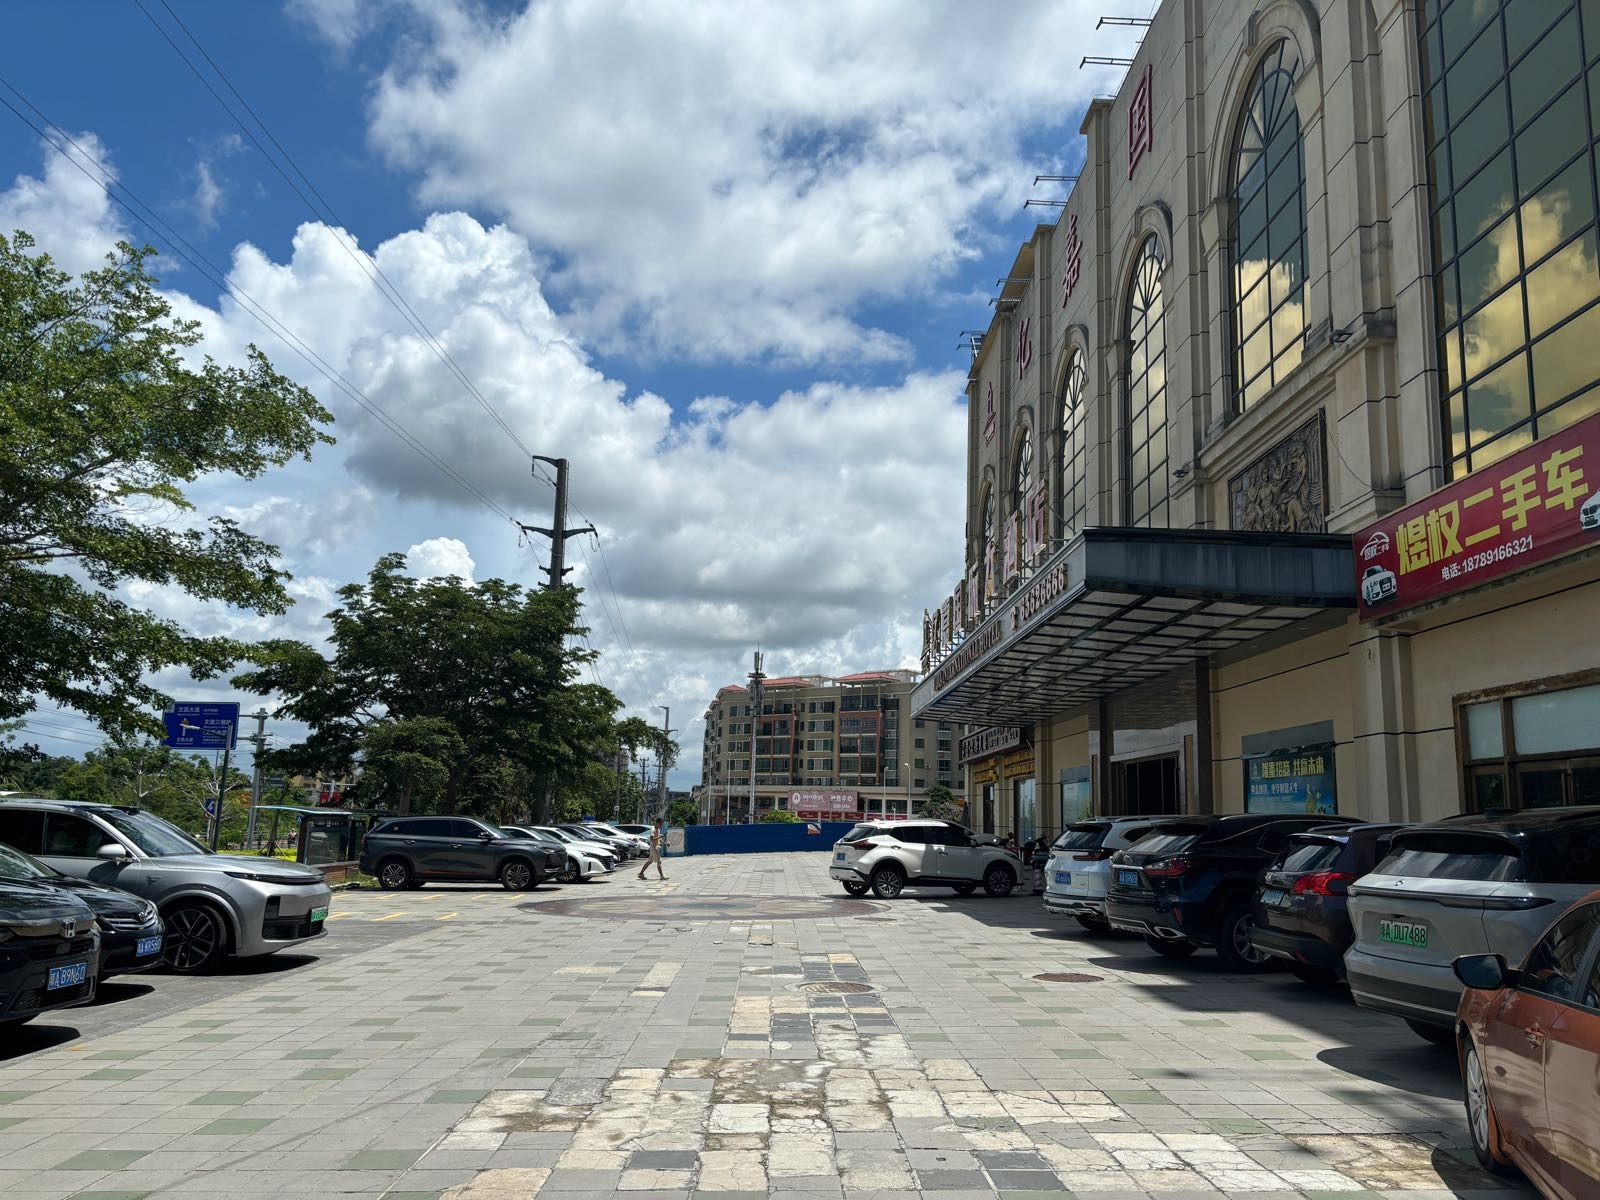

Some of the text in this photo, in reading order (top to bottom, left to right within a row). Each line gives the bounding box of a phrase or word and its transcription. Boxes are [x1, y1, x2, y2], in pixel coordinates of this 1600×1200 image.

[1395, 444, 1589, 576] 煜权二手车
[1462, 535, 1533, 574] 18789166321
[1293, 756, 1325, 777] 共赢未来
